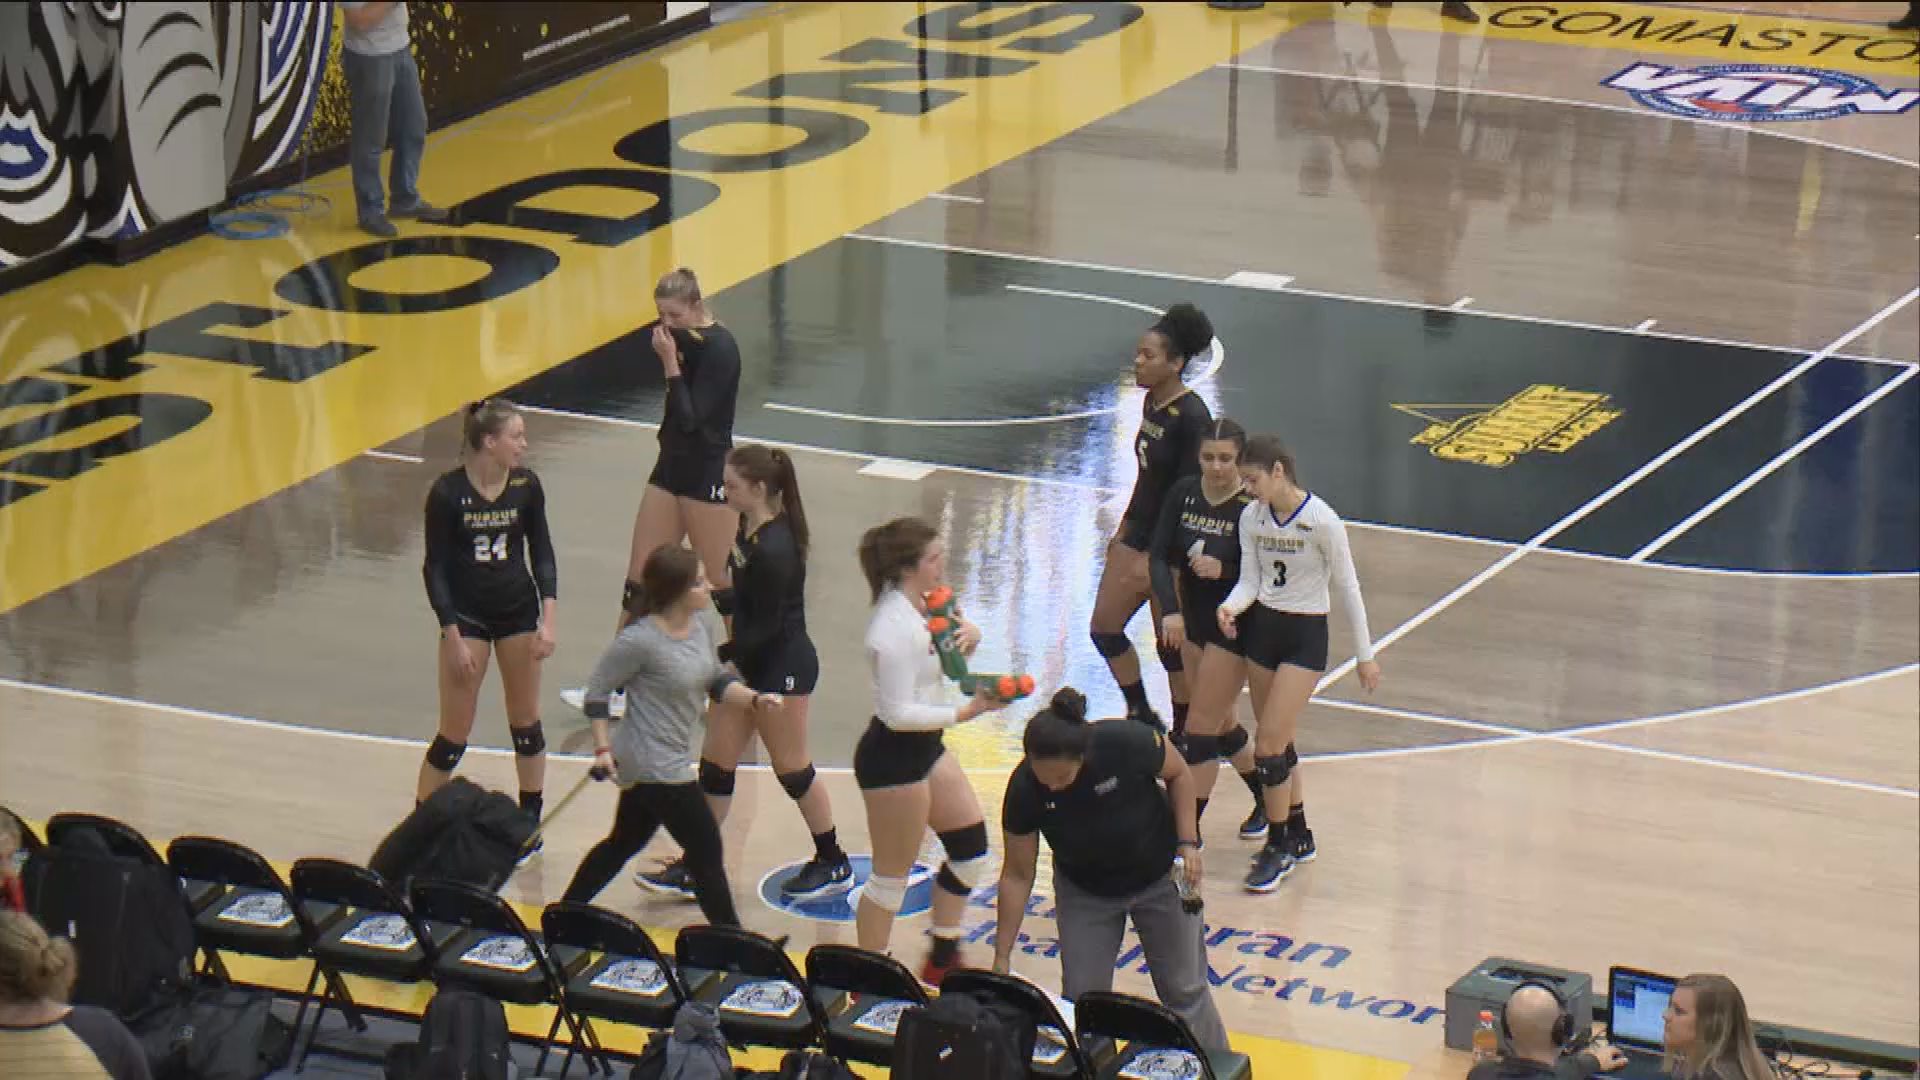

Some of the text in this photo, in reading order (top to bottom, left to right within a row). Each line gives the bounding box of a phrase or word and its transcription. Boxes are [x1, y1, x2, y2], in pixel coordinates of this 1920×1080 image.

[1488, 5, 1919, 63] GOMASTO
[0, 2, 1145, 504] STODONS
[473, 533, 508, 562] 24
[1273, 560, 1287, 588] 3
[1206, 965, 1446, 1025] Networ
